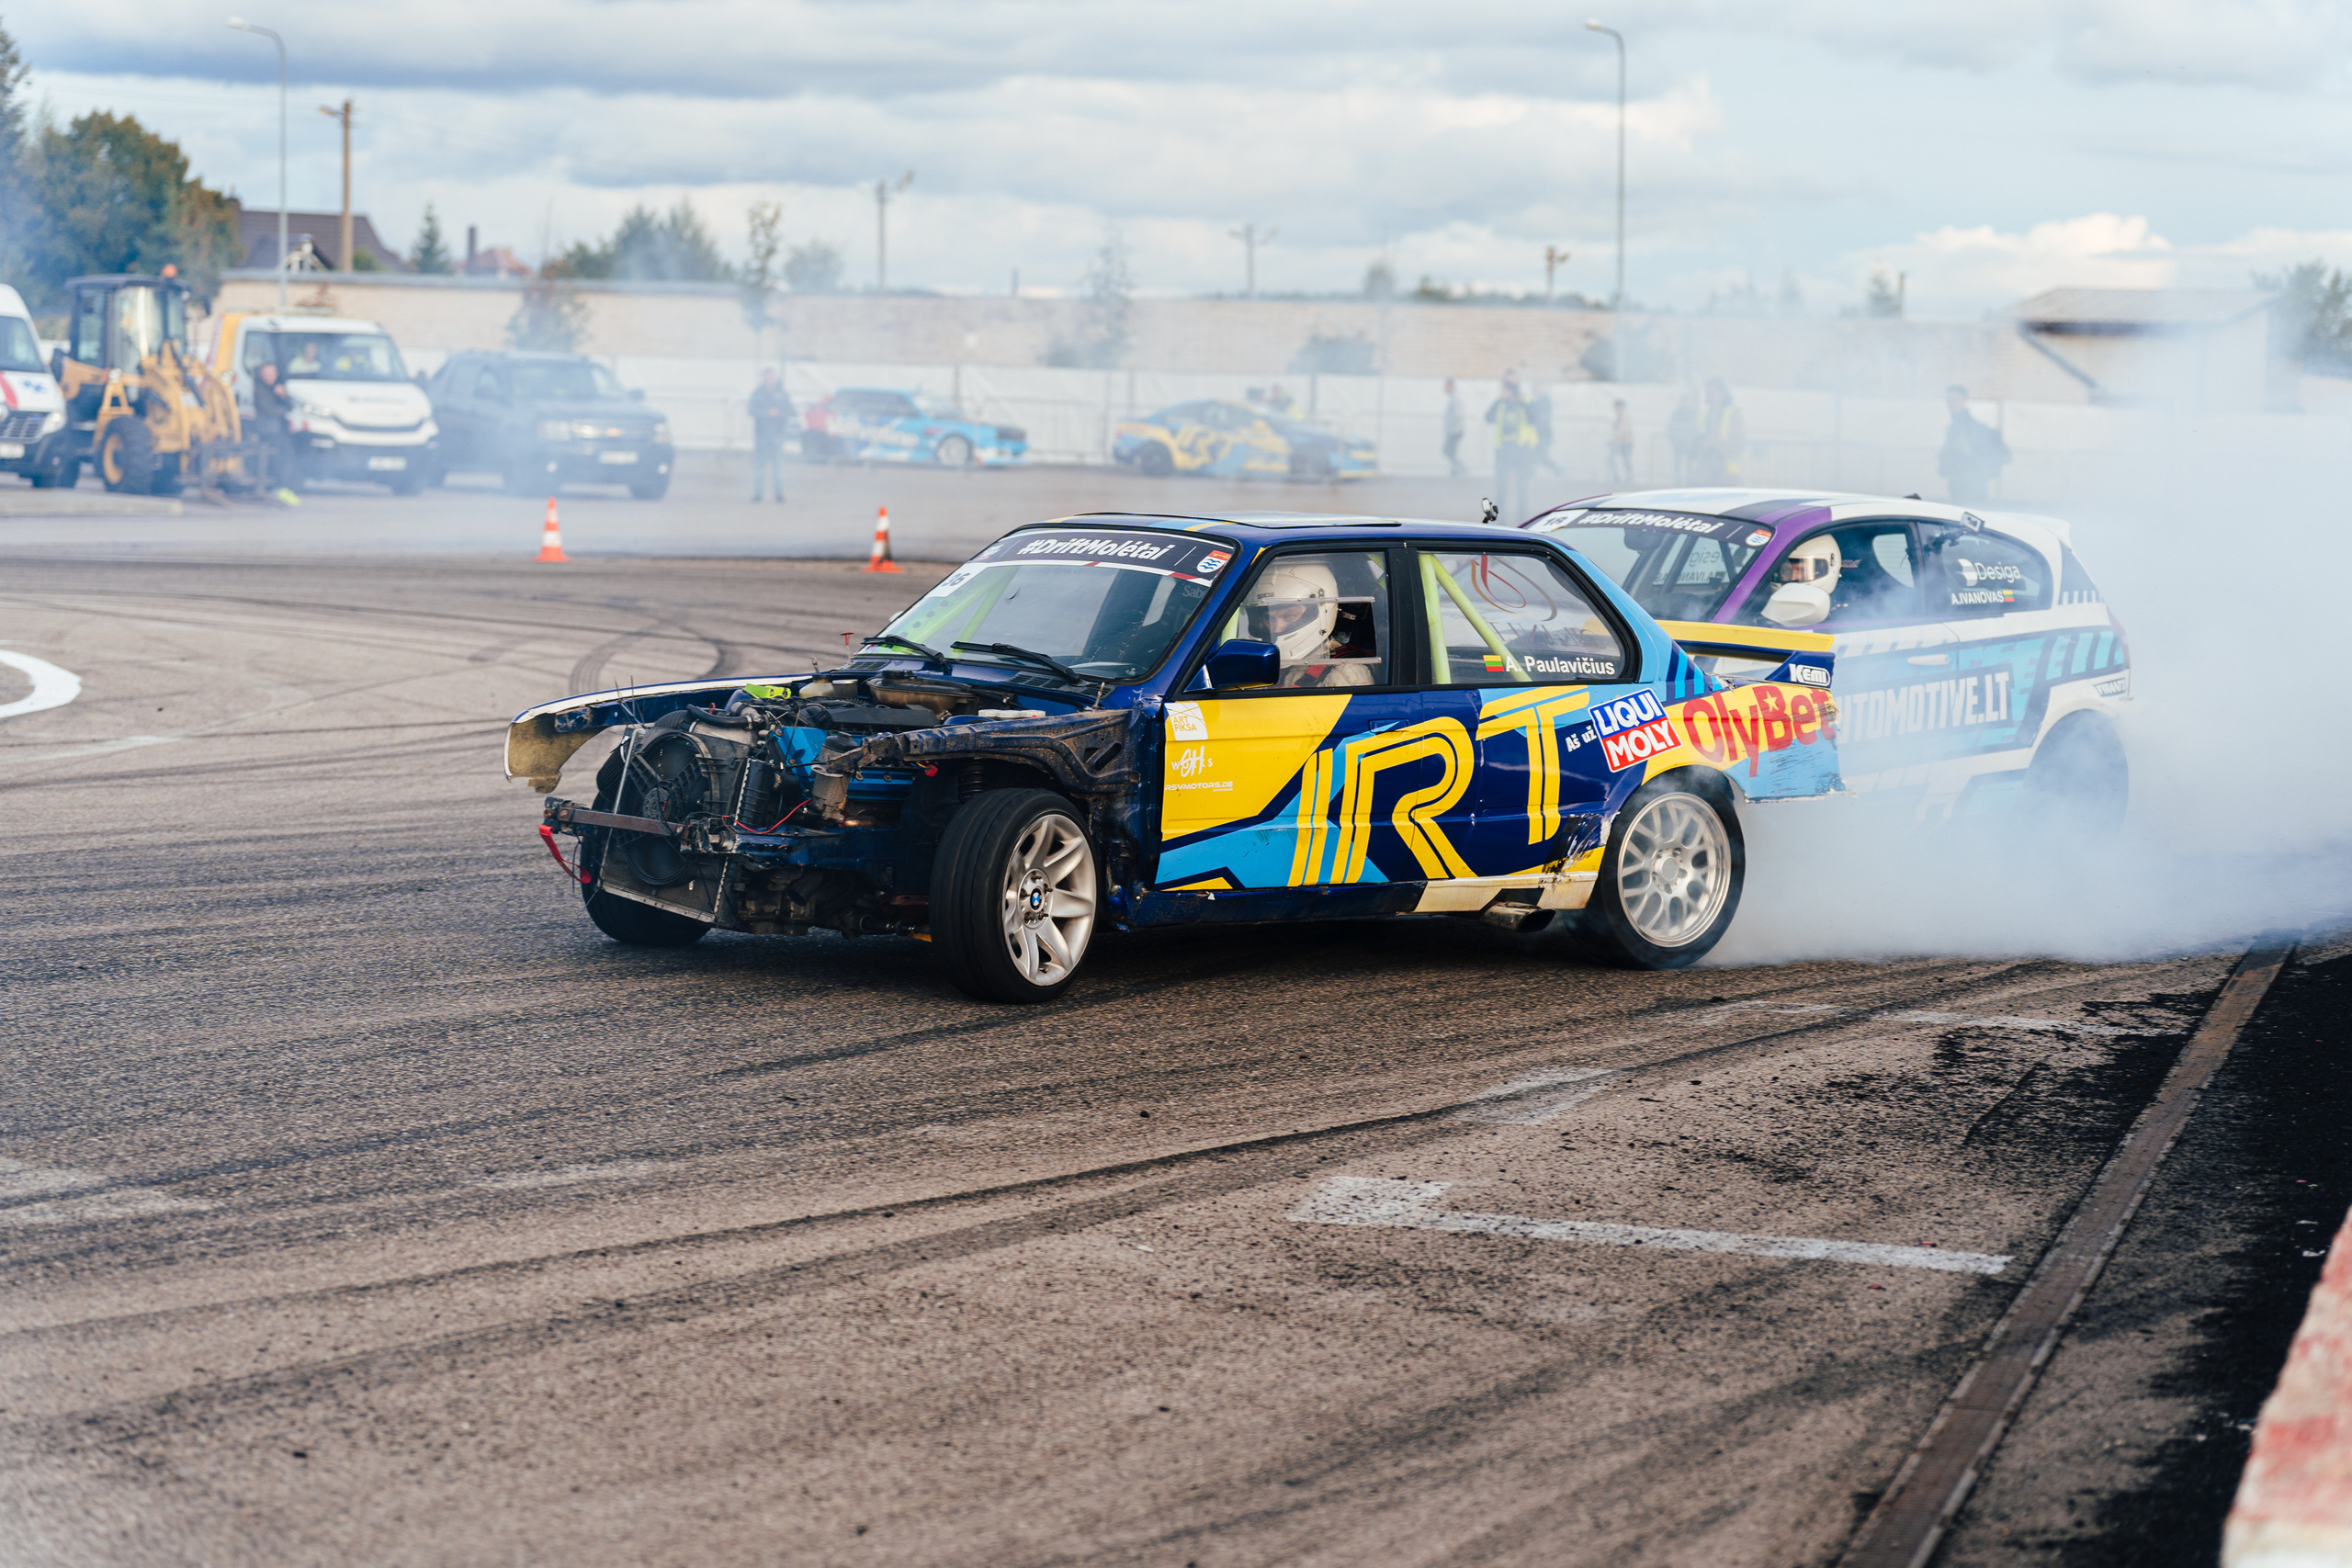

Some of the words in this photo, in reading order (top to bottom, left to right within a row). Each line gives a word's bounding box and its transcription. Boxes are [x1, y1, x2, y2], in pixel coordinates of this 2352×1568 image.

[1974, 561, 2020, 583] Desiga
[1951, 591, 2004, 604] A.IVANOVAS
[1506, 656, 1521, 671] A.
[1524, 656, 1615, 674] Paulavičius
[1592, 689, 1664, 733] LIQUI
[1836, 671, 2009, 744] UTOMOTIVE.LT
[1174, 723, 1197, 731] FIKSA
[1566, 733, 1581, 752] Aš
[1581, 725, 1598, 743] už
[1683, 685, 1836, 777] OlyBet
[1605, 720, 1674, 767] MOLY
[1164, 781, 1233, 791] RSVMOTORS.DE
